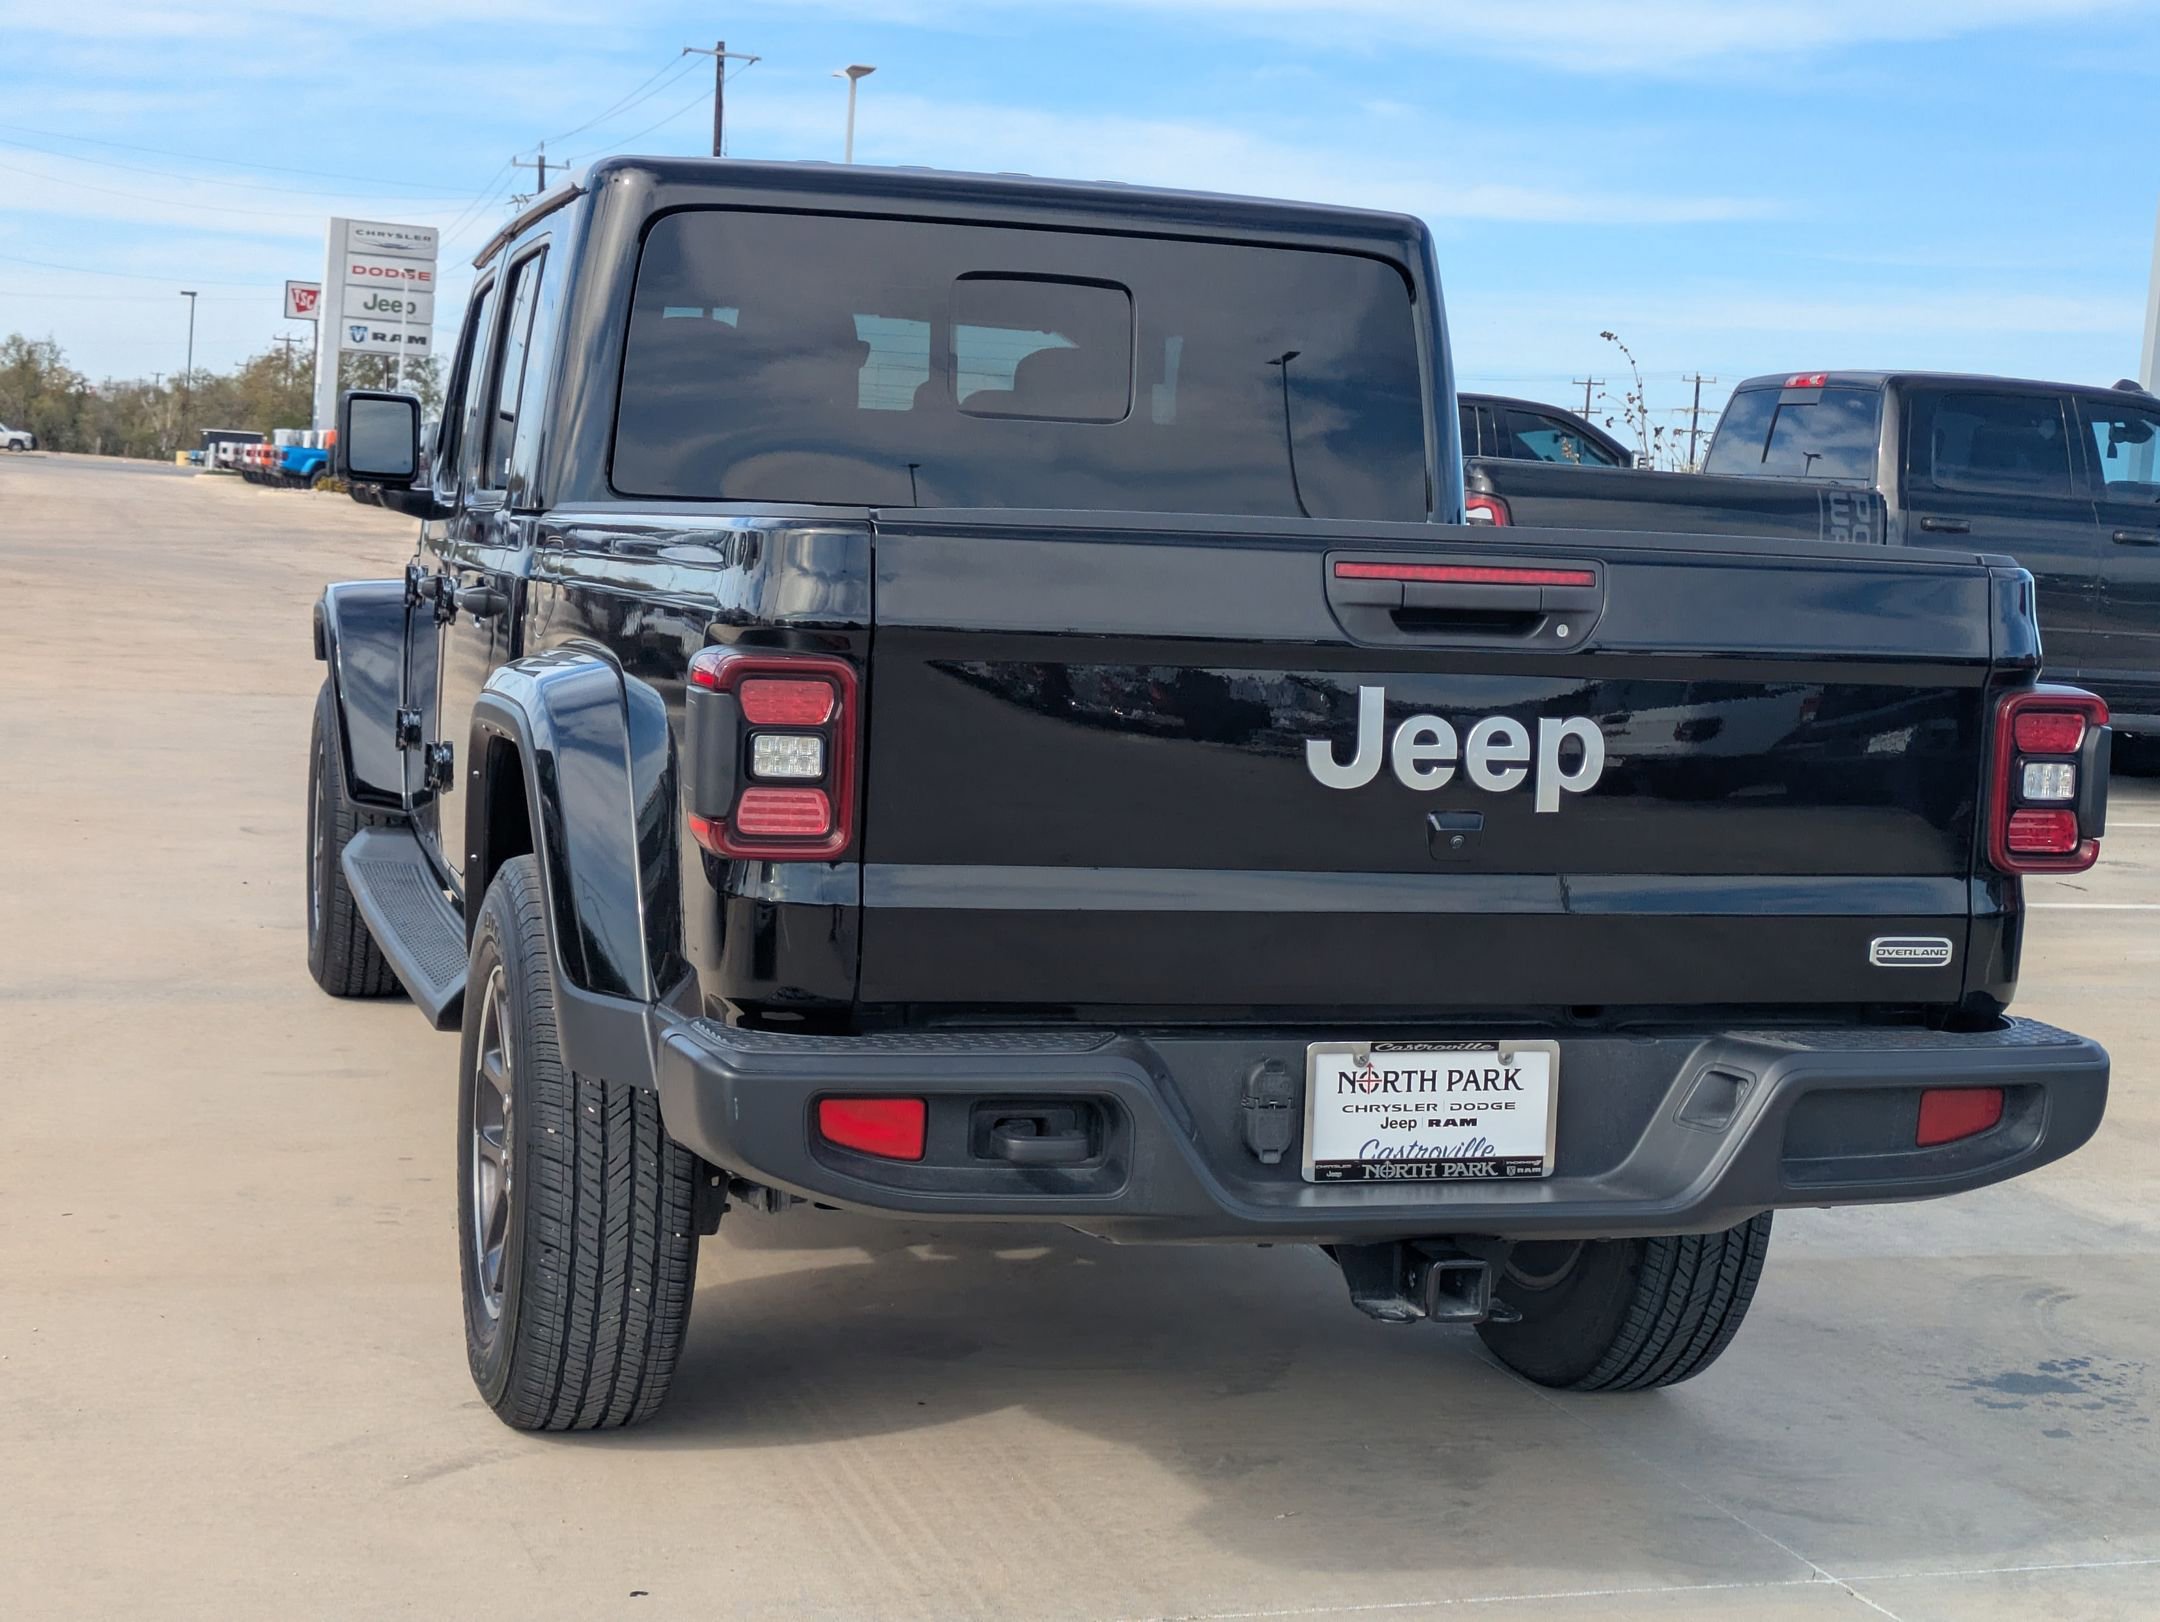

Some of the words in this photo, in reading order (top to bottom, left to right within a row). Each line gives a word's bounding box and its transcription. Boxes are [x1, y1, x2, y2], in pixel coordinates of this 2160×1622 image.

[355, 229, 431, 241] CHRYSLER
[352, 265, 431, 281] DODGE
[294, 289, 314, 310] TSC
[372, 332, 427, 345] RAM
[1306, 685, 1605, 813] Jeep
[1876, 948, 1949, 956] OVERLAND
[1374, 1042, 1495, 1052] Castroville
[1337, 1068, 1437, 1095] NORTH
[1446, 1068, 1524, 1092] PARK
[1342, 1103, 1438, 1113] CHRYSLER
[1450, 1102, 1516, 1111] DODGE
[1380, 1117, 1417, 1131] Jeep
[1428, 1118, 1478, 1127] RAM
[1359, 1137, 1496, 1159] Castroville
[1362, 1161, 1437, 1179] NORTH
[1442, 1161, 1499, 1177] PARK
